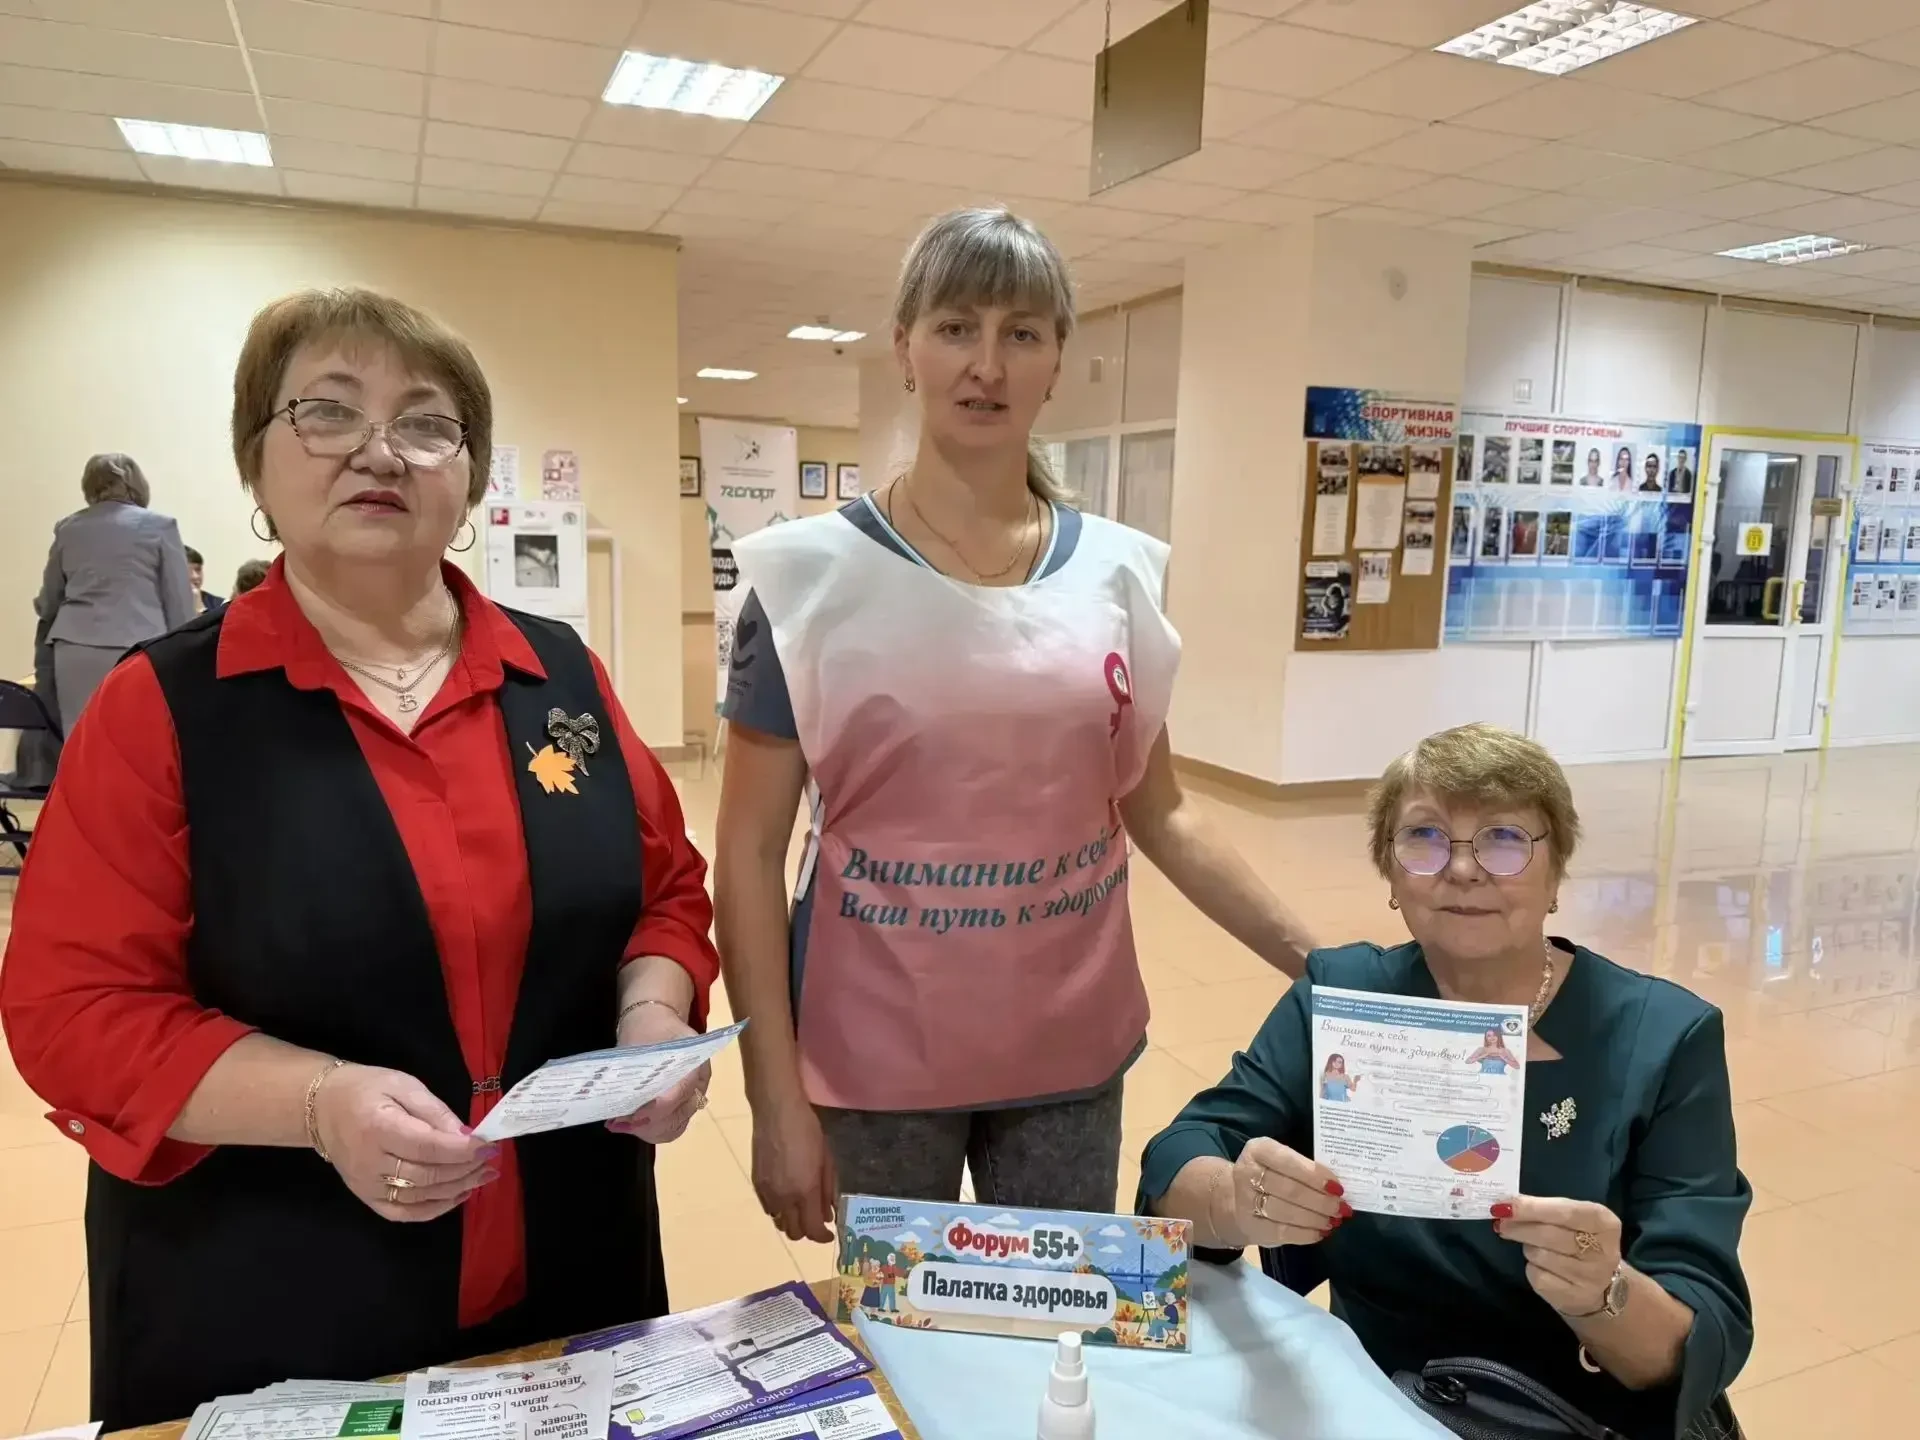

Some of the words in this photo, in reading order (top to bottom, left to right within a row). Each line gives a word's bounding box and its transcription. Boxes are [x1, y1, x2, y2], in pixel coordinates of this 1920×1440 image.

[1362, 405, 1454, 423] СПОРТИВНАЯ
[1403, 424, 1453, 439] ЖИЗНЬ
[1504, 420, 1550, 434] ЛУЧШИЕ
[1552, 424, 1623, 439] СПОРТСМЕНЫ
[840, 848, 1045, 887] Внимание
[1053, 852, 1071, 878] к
[840, 891, 908, 926] Ваш
[919, 906, 1006, 934] путь
[1017, 904, 1035, 924] к
[1321, 1019, 1376, 1037] Внимание
[1377, 1031, 1385, 1039] к
[1387, 1029, 1409, 1042] себе
[1341, 1034, 1367, 1048] Ваш
[860, 1206, 902, 1215] АКТИВНОЕ
[855, 1215, 905, 1224] ДОЛГОЛЕТИЕ
[947, 1223, 1029, 1258] Форум
[1032, 1230, 1079, 1260] 55+
[922, 1271, 1007, 1303] Палатка
[1012, 1282, 1108, 1312] здоровья
[505, 1375, 582, 1395] ДЕЙСТВОВАТЬ
[417, 1395, 468, 1407] БЫСТРО!
[471, 1390, 503, 1401] НАДО
[510, 1395, 549, 1408] ДЕЛАТЬ
[757, 1388, 794, 1404] ОНКО
[530, 1405, 549, 1413] ЧТО
[709, 1402, 755, 1421] МИФЫ
[541, 1412, 588, 1426] ЧЕЛОВЕК
[534, 1420, 588, 1436] ВНЕЗАПНО
[561, 1428, 588, 1439] ЕСЛИ
